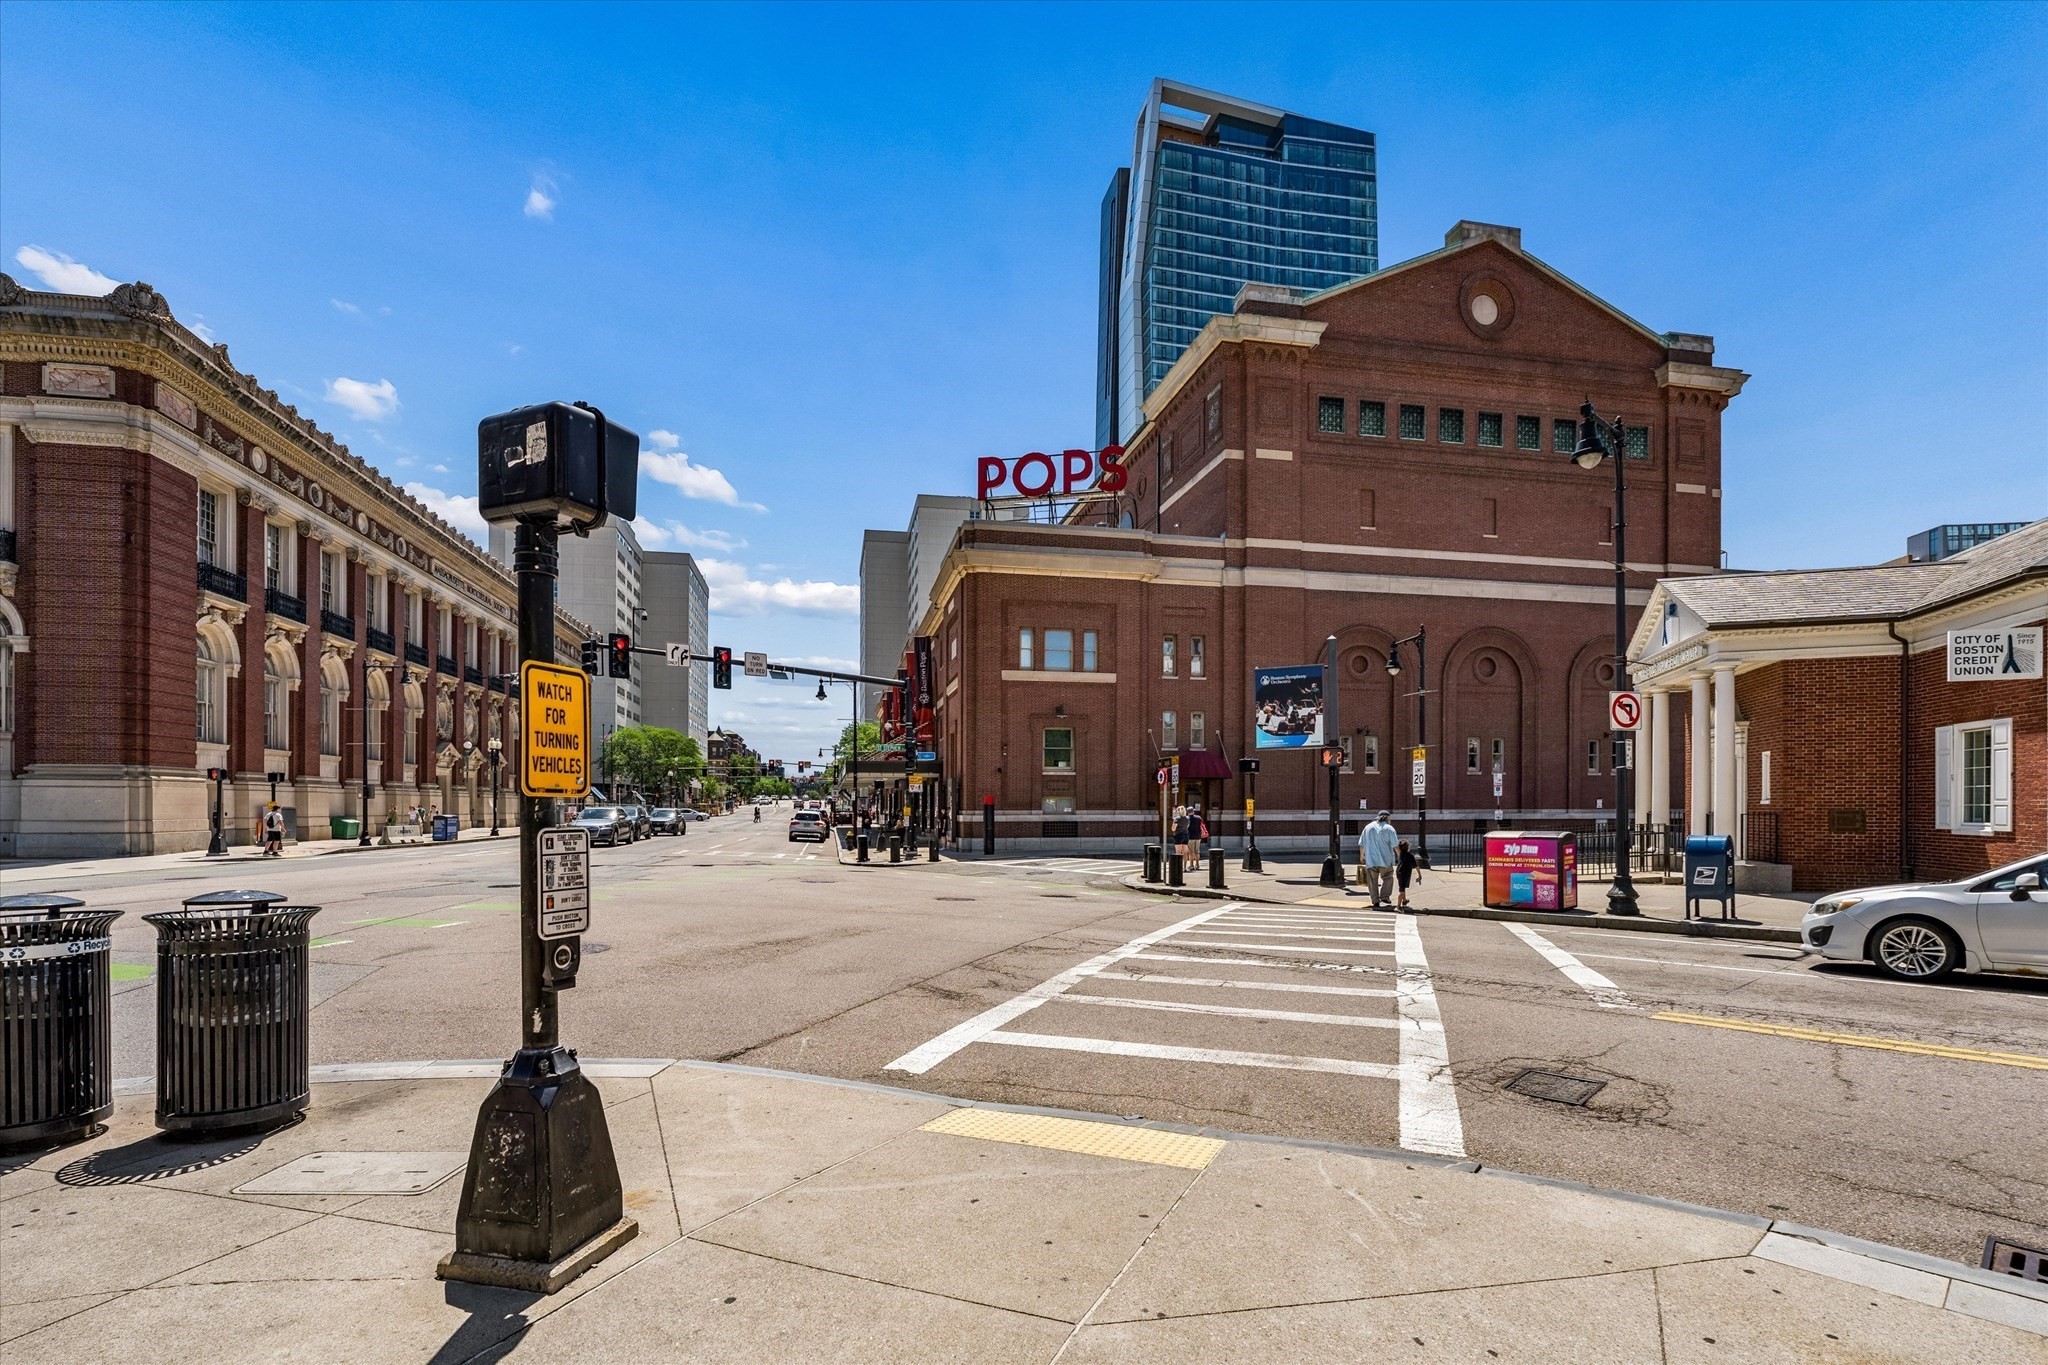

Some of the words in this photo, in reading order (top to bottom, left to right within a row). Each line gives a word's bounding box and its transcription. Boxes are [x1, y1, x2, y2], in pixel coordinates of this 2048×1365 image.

[978, 444, 1127, 501] POPS
[1954, 635, 1981, 645] CITY
[1984, 634, 2001, 644] OF
[1954, 644, 2004, 655] BOSTON
[919, 651, 928, 668] Pops
[1954, 655, 2000, 666] CREDIT
[1954, 666, 1994, 676] UNION
[920, 668, 928, 692] Boston
[537, 681, 572, 702] WATCH
[545, 707, 566, 725] FOR
[534, 730, 579, 751] TURNING
[1336, 751, 1342, 764] 2
[532, 755, 582, 774] VEHICLES
[1413, 773, 1424, 785] 20
[1520, 844, 1539, 854] Run
[564, 912, 579, 920] BUTTON
